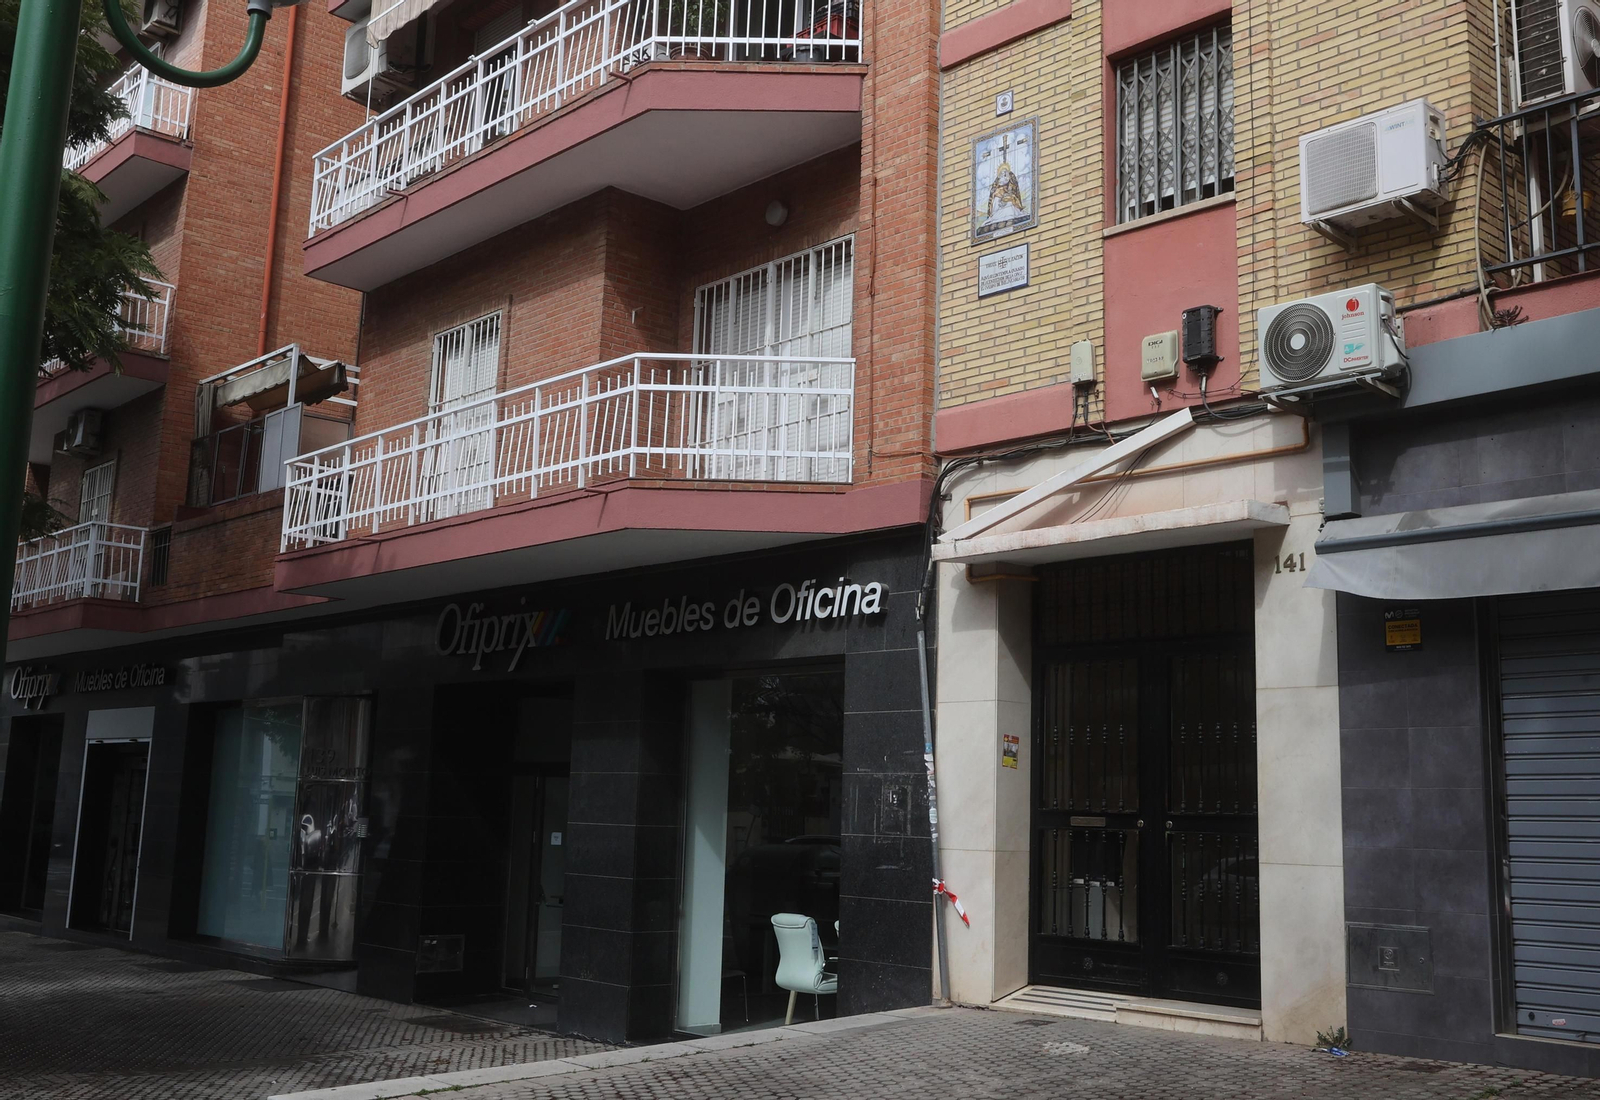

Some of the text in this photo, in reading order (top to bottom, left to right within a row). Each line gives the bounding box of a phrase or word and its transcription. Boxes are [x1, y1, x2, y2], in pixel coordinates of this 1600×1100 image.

[1274, 552, 1306, 574] 141
[435, 577, 885, 673] Ofiprix Muebles de Oficina
[10, 663, 166, 711] Ofiprix Muebles de Oficina
